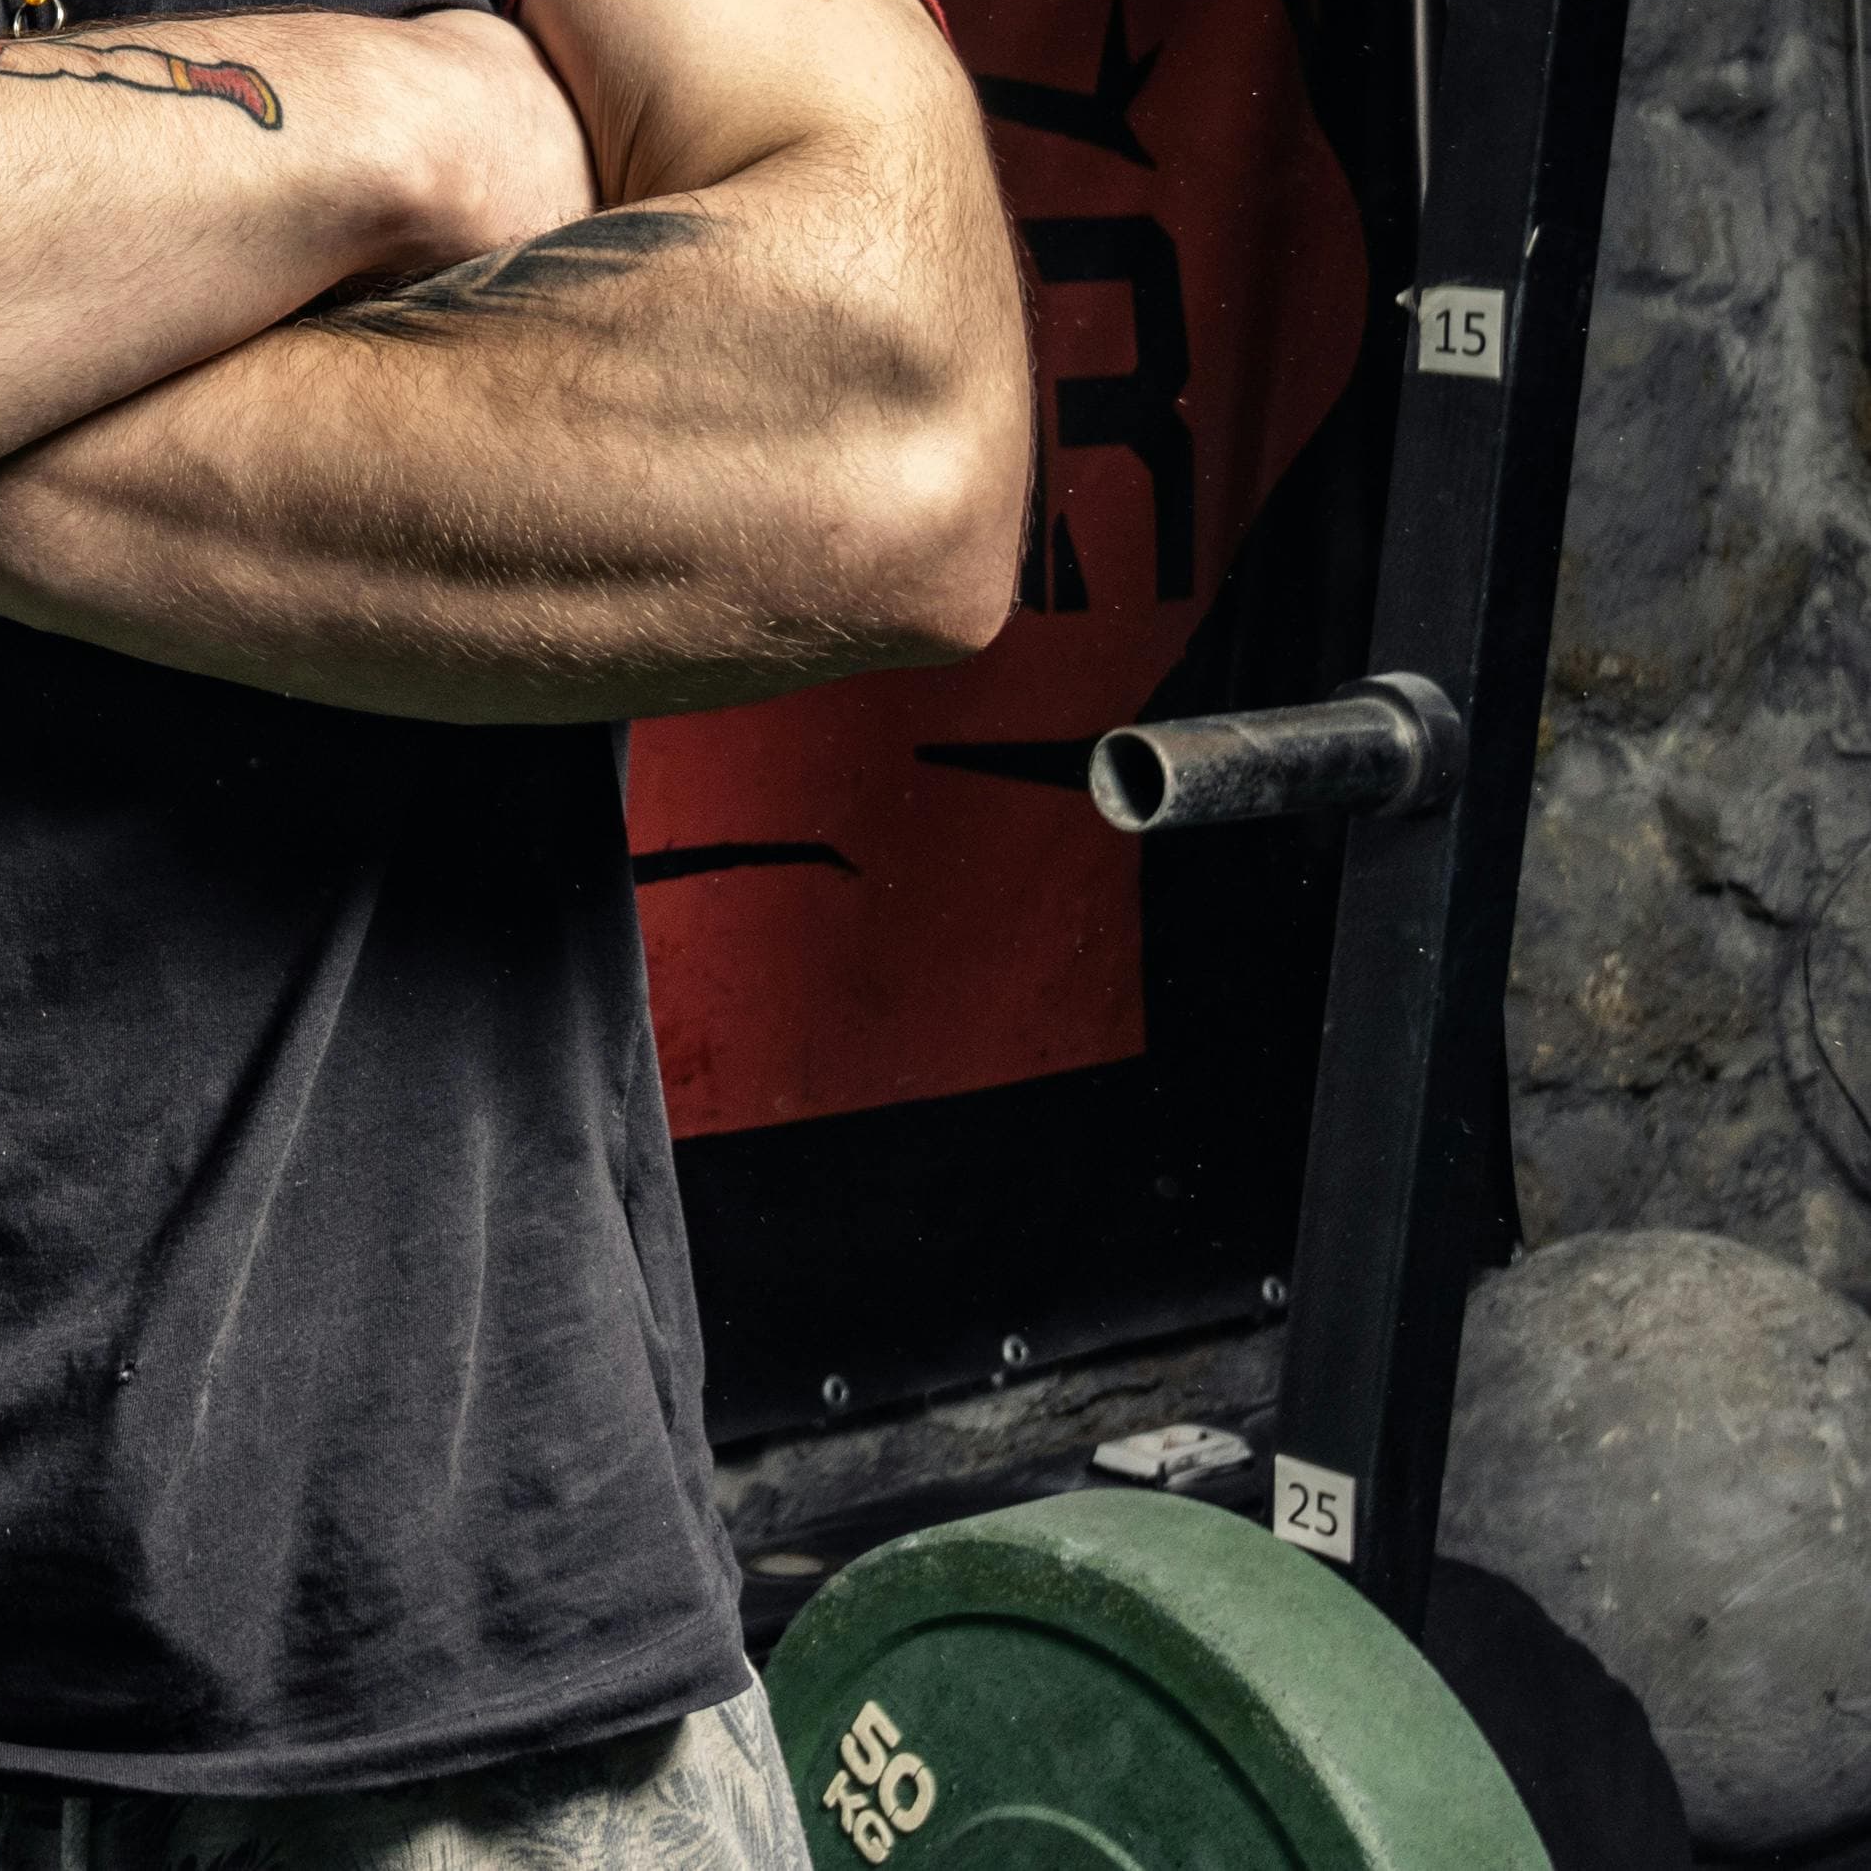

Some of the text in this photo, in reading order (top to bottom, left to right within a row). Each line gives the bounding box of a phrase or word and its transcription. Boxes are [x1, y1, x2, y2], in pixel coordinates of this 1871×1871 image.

[1435, 309, 1486, 356] 15
[1018, 216, 1195, 612] R
[1287, 1482, 1339, 1537] 25
[840, 1699, 938, 1833] 50
[823, 1770, 895, 1866] KG
